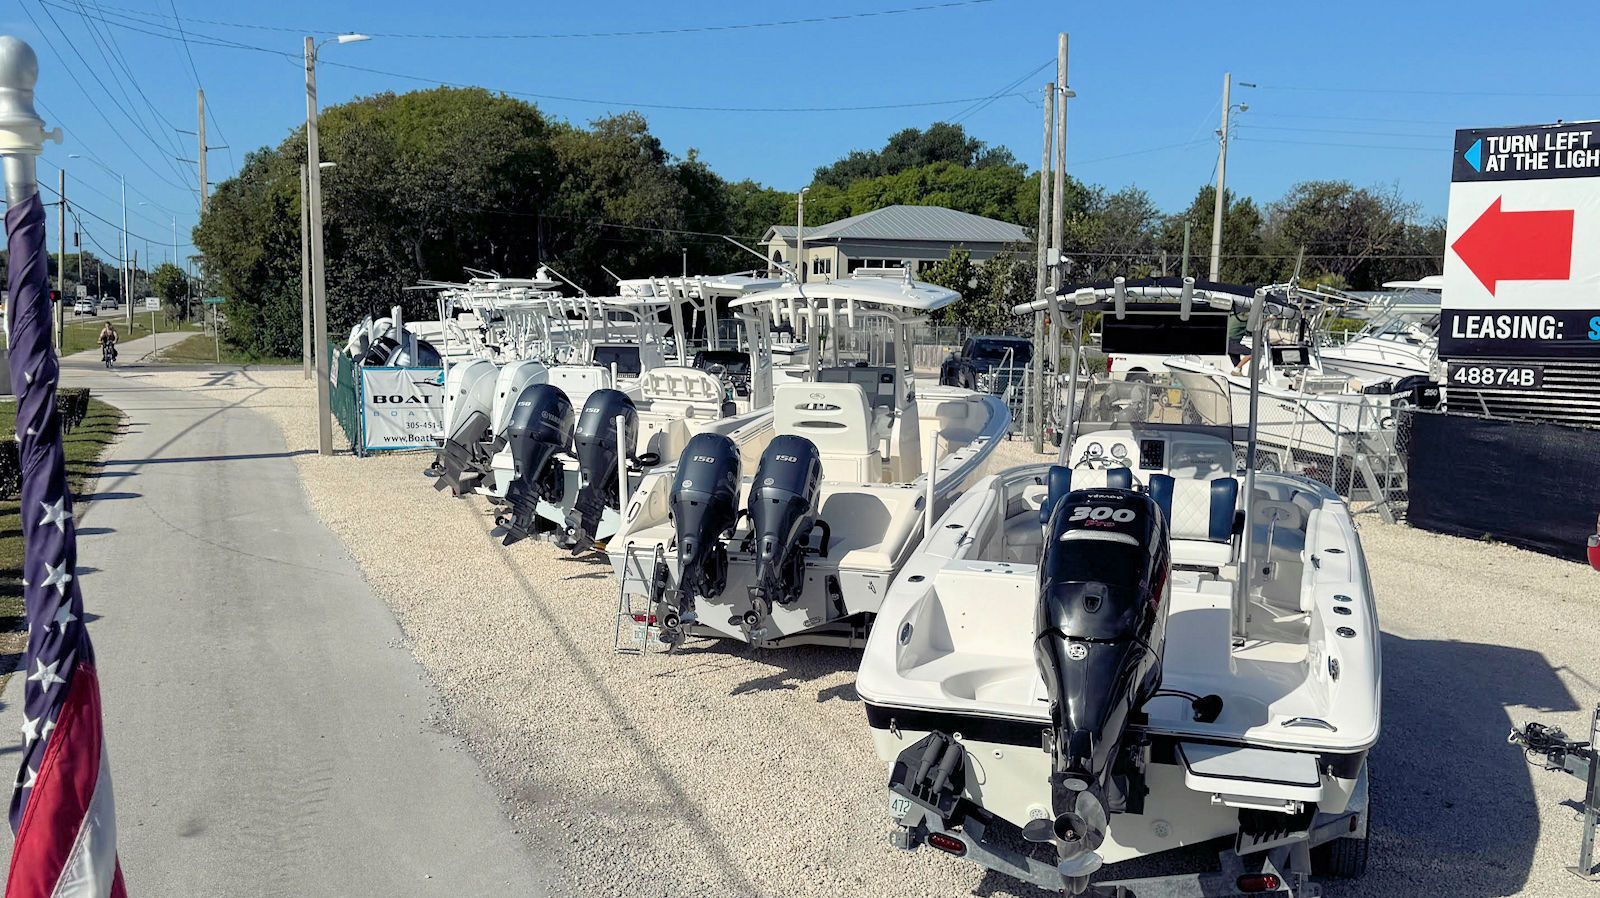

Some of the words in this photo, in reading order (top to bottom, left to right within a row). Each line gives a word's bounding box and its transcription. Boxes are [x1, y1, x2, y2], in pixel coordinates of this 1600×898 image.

[1487, 135, 1538, 154] TURN
[1545, 131, 1593, 151] LEFT
[1485, 154, 1510, 172] AT
[1513, 151, 1549, 171] THE
[1555, 149, 1600, 169] LIGH
[1451, 315, 1564, 340] LEASING:
[1453, 367, 1535, 387] 48874B
[373, 395, 433, 404] BOAT
[693, 455, 715, 464] 150
[775, 454, 798, 463] 150
[1068, 506, 1136, 522] 300
